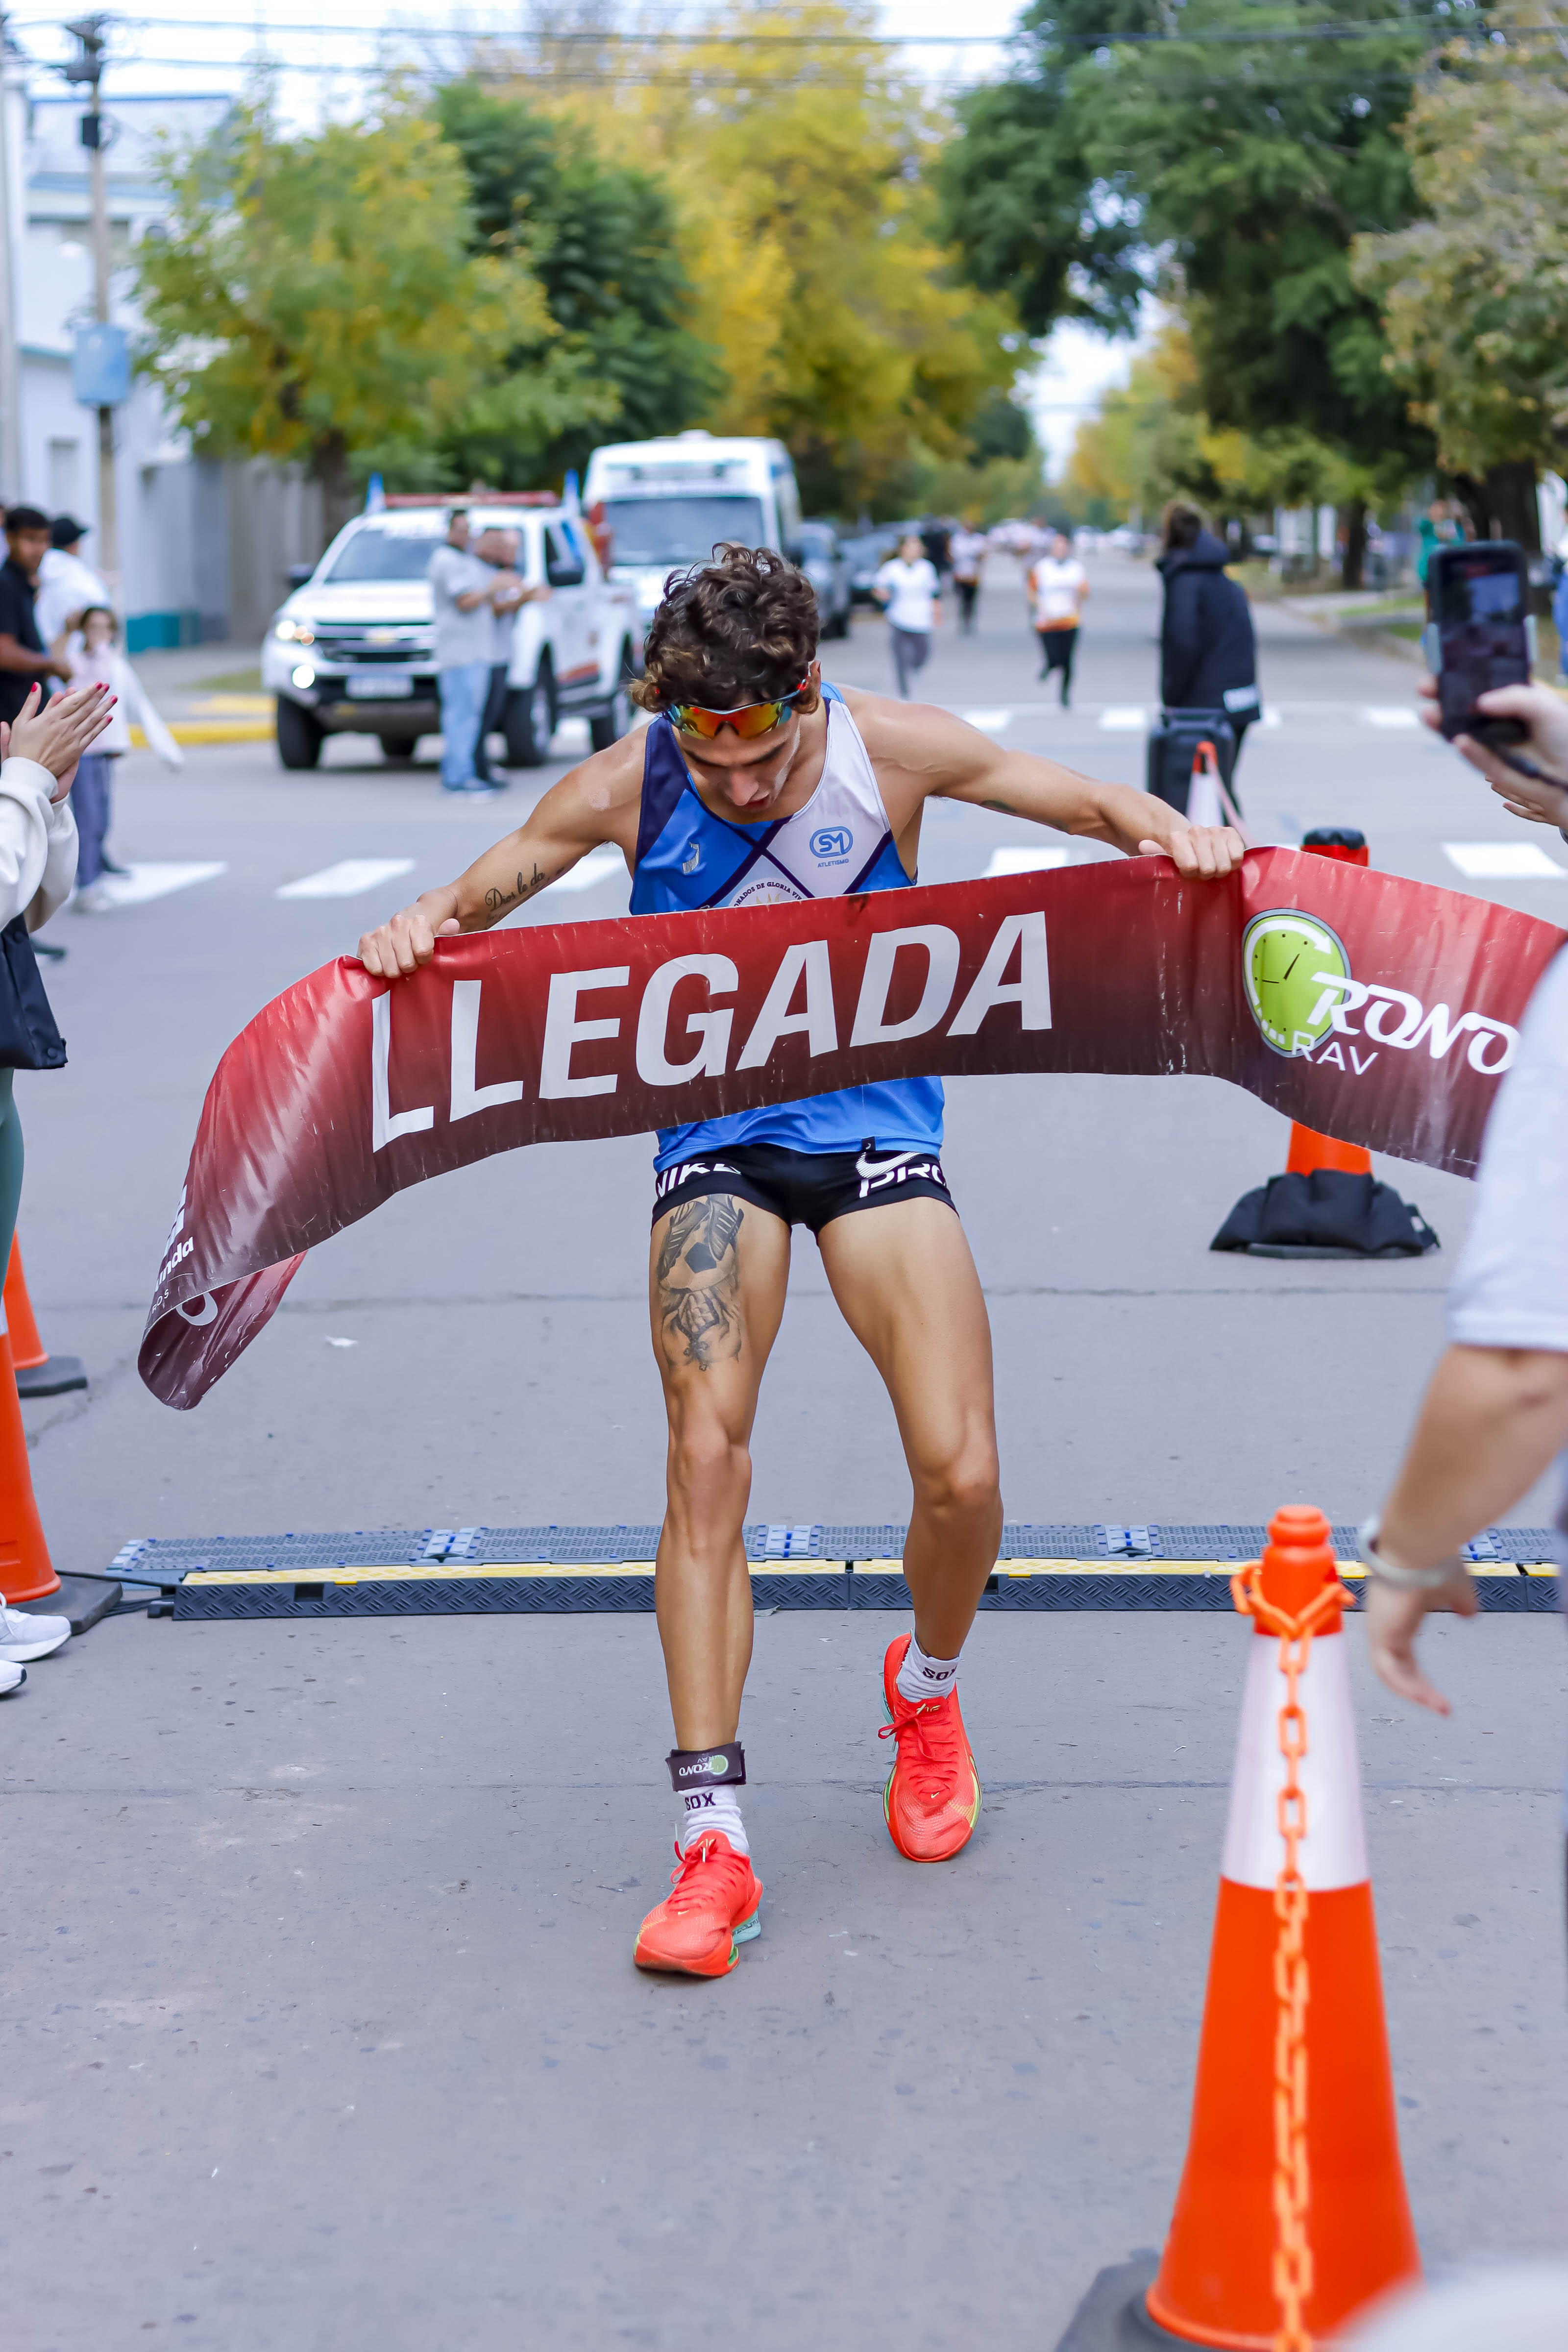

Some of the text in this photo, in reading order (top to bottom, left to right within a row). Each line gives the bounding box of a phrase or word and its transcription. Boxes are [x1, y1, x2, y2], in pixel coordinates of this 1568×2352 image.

[819, 833, 845, 855] SM
[817, 858, 849, 868] ATLETISMO
[767, 882, 790, 893] GLORIA
[371, 910, 1053, 1153] LLEGADA
[1291, 1030, 1379, 1076] RAV
[685, 1792, 716, 1811] SOX
